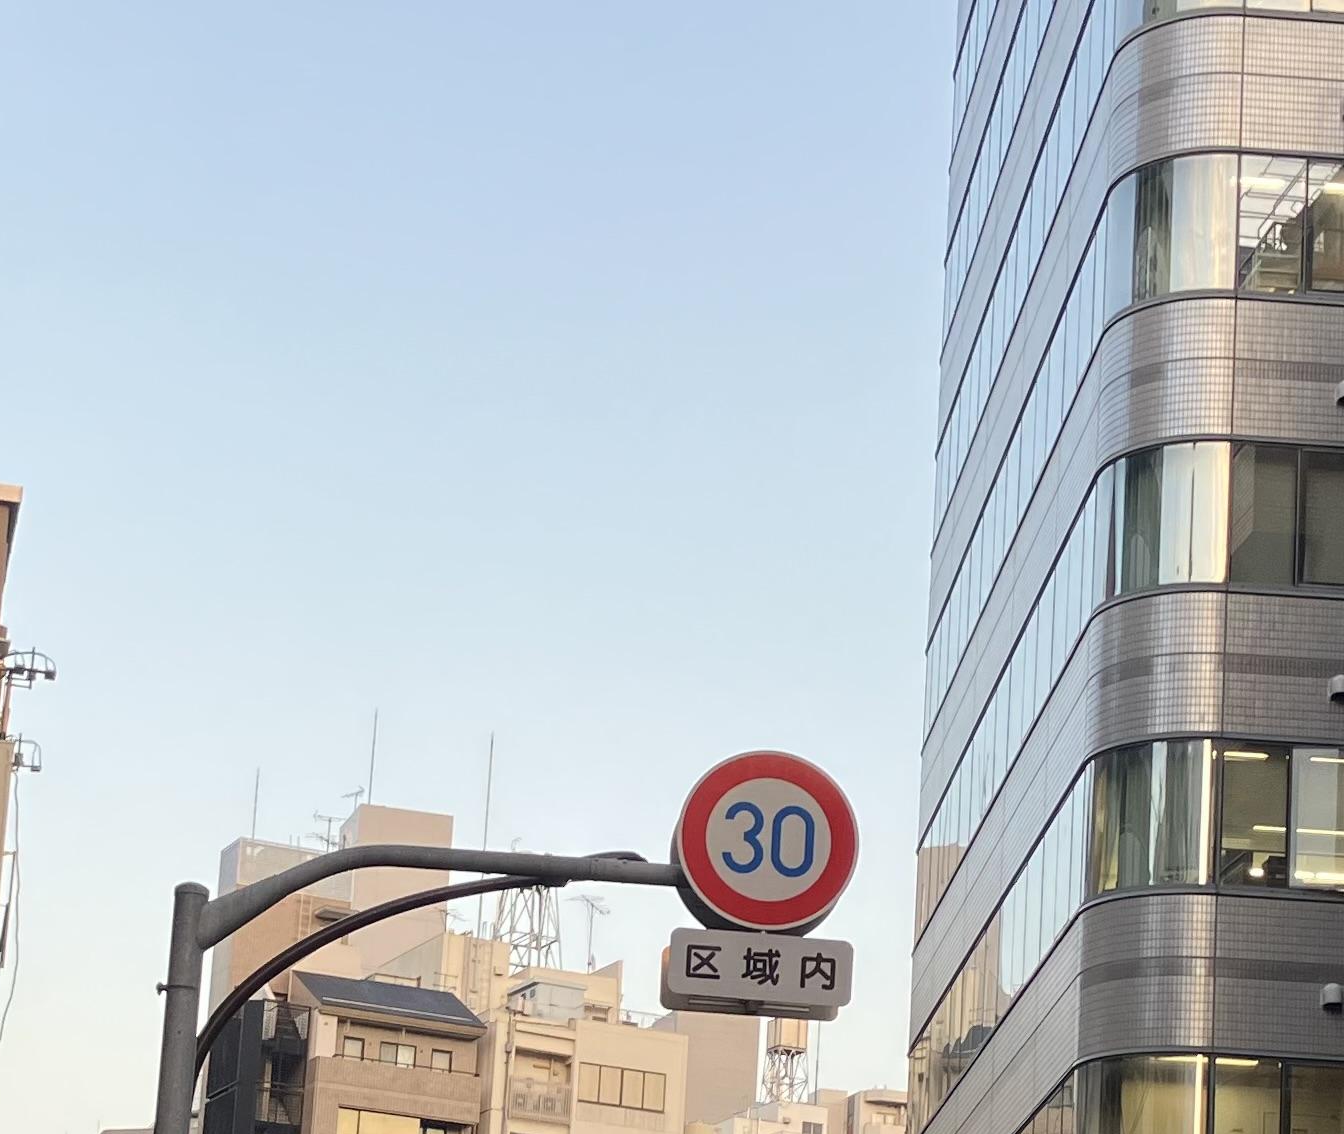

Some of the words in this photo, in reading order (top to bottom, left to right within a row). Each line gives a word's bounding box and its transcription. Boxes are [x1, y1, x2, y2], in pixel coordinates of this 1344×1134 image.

[721, 801, 815, 877] 30
[686, 944, 836, 990] 区域内
